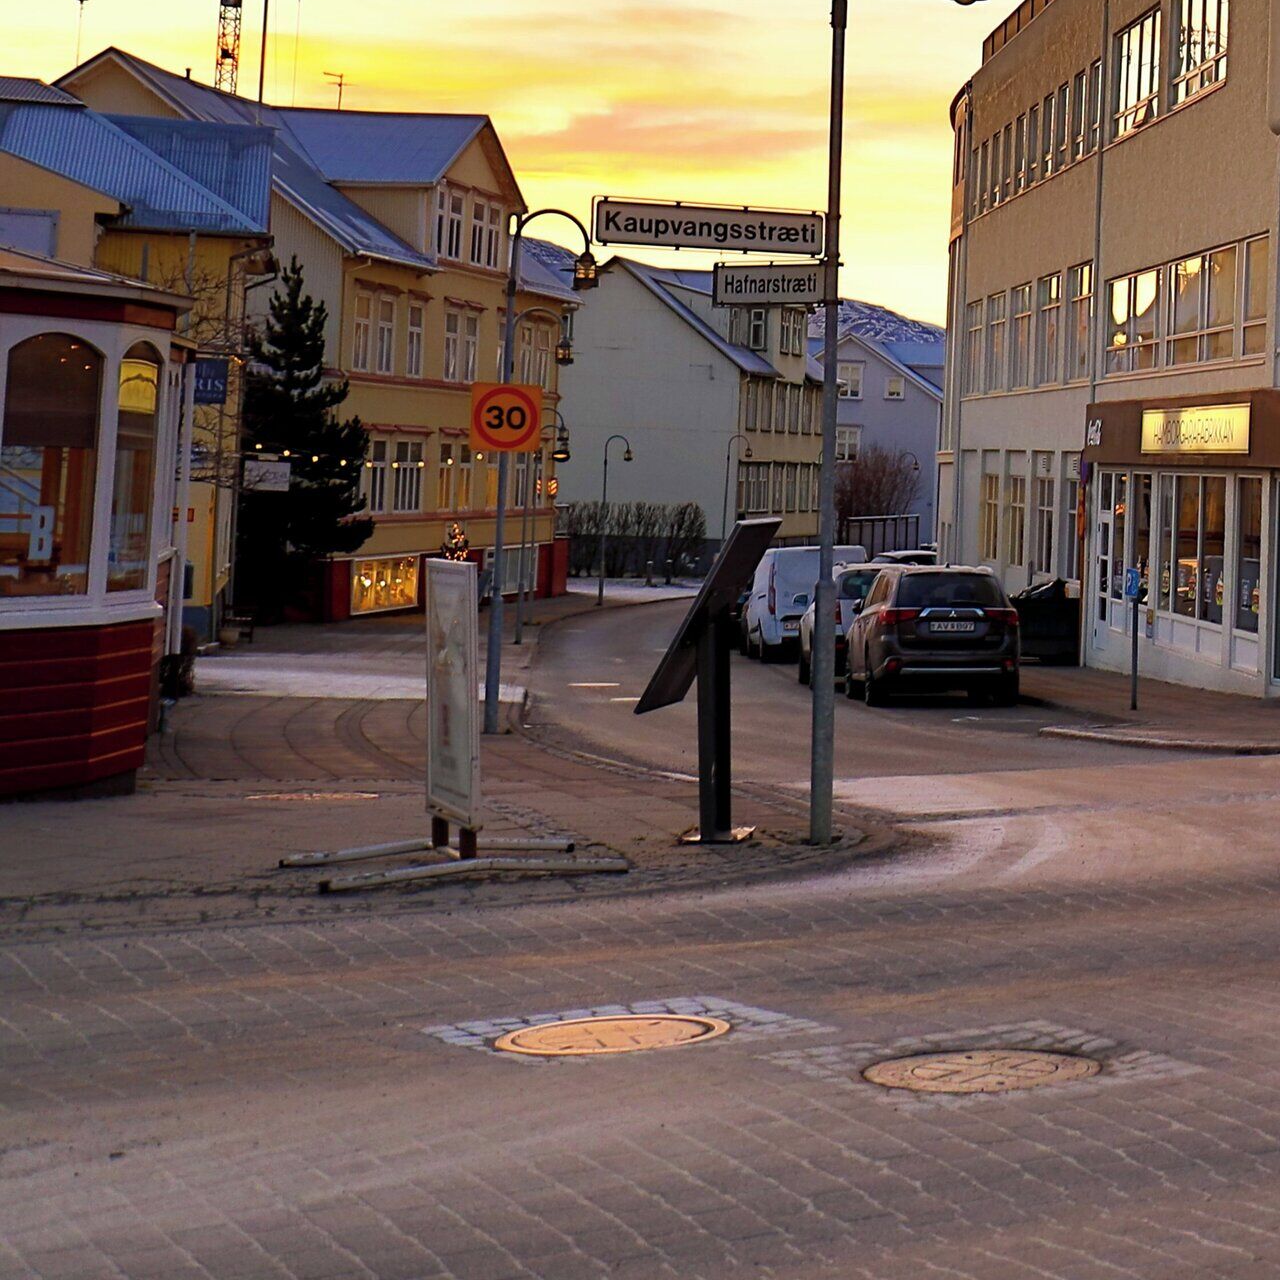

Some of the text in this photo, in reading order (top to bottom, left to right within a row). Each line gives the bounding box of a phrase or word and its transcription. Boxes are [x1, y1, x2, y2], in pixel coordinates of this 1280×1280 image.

[604, 211, 816, 243] Kaupvangsstræti
[724, 273, 817, 294] Hafnarstræti
[485, 405, 526, 430] 30
